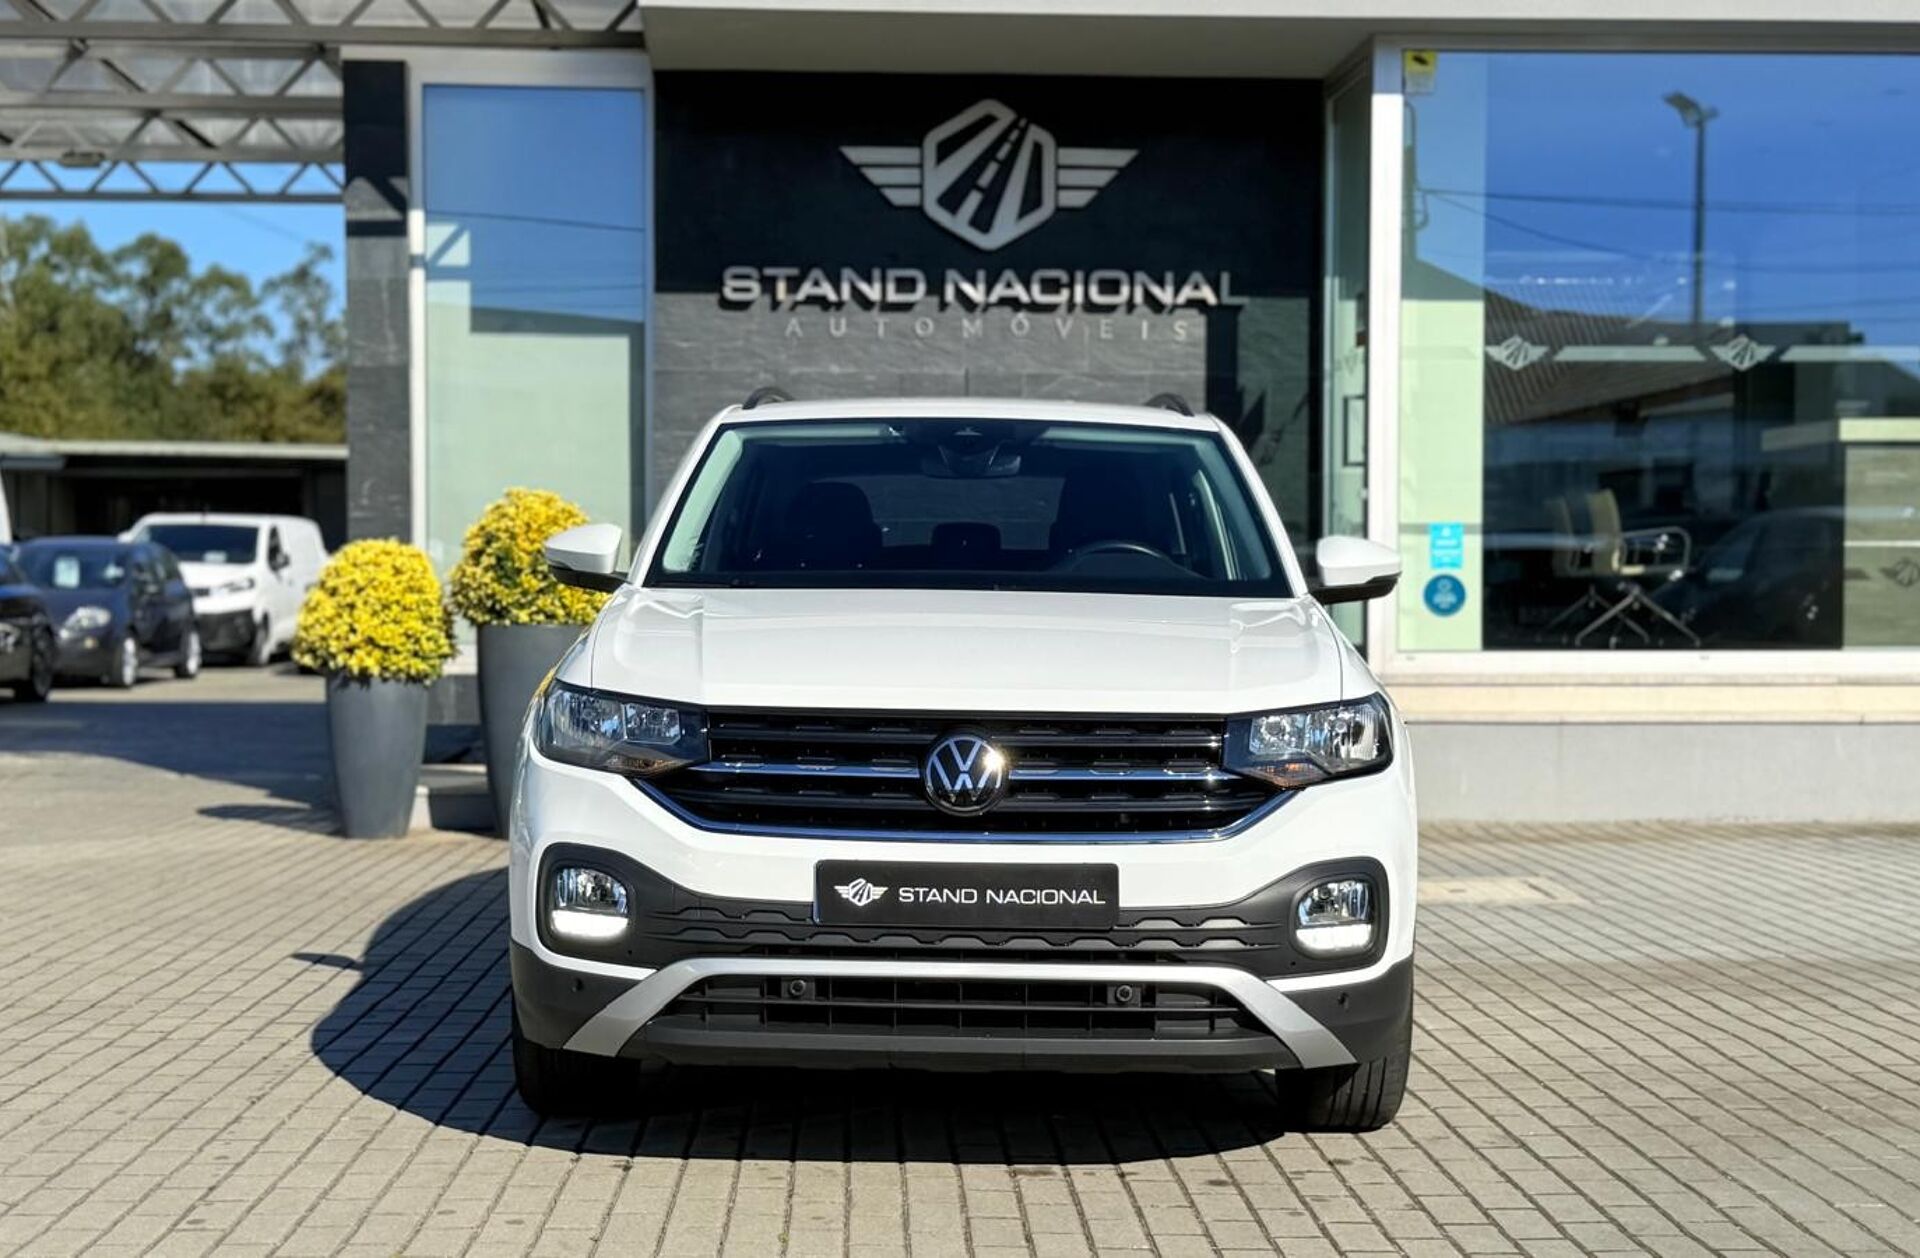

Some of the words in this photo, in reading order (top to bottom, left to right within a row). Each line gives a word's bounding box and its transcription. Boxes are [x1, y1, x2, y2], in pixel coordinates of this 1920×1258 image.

[722, 266, 927, 302] STAND
[944, 268, 1249, 306] NACIONAL
[784, 311, 1189, 342] AUTOMÓVEIS
[898, 886, 978, 905] STAND
[985, 888, 1106, 905] NACIONAL
